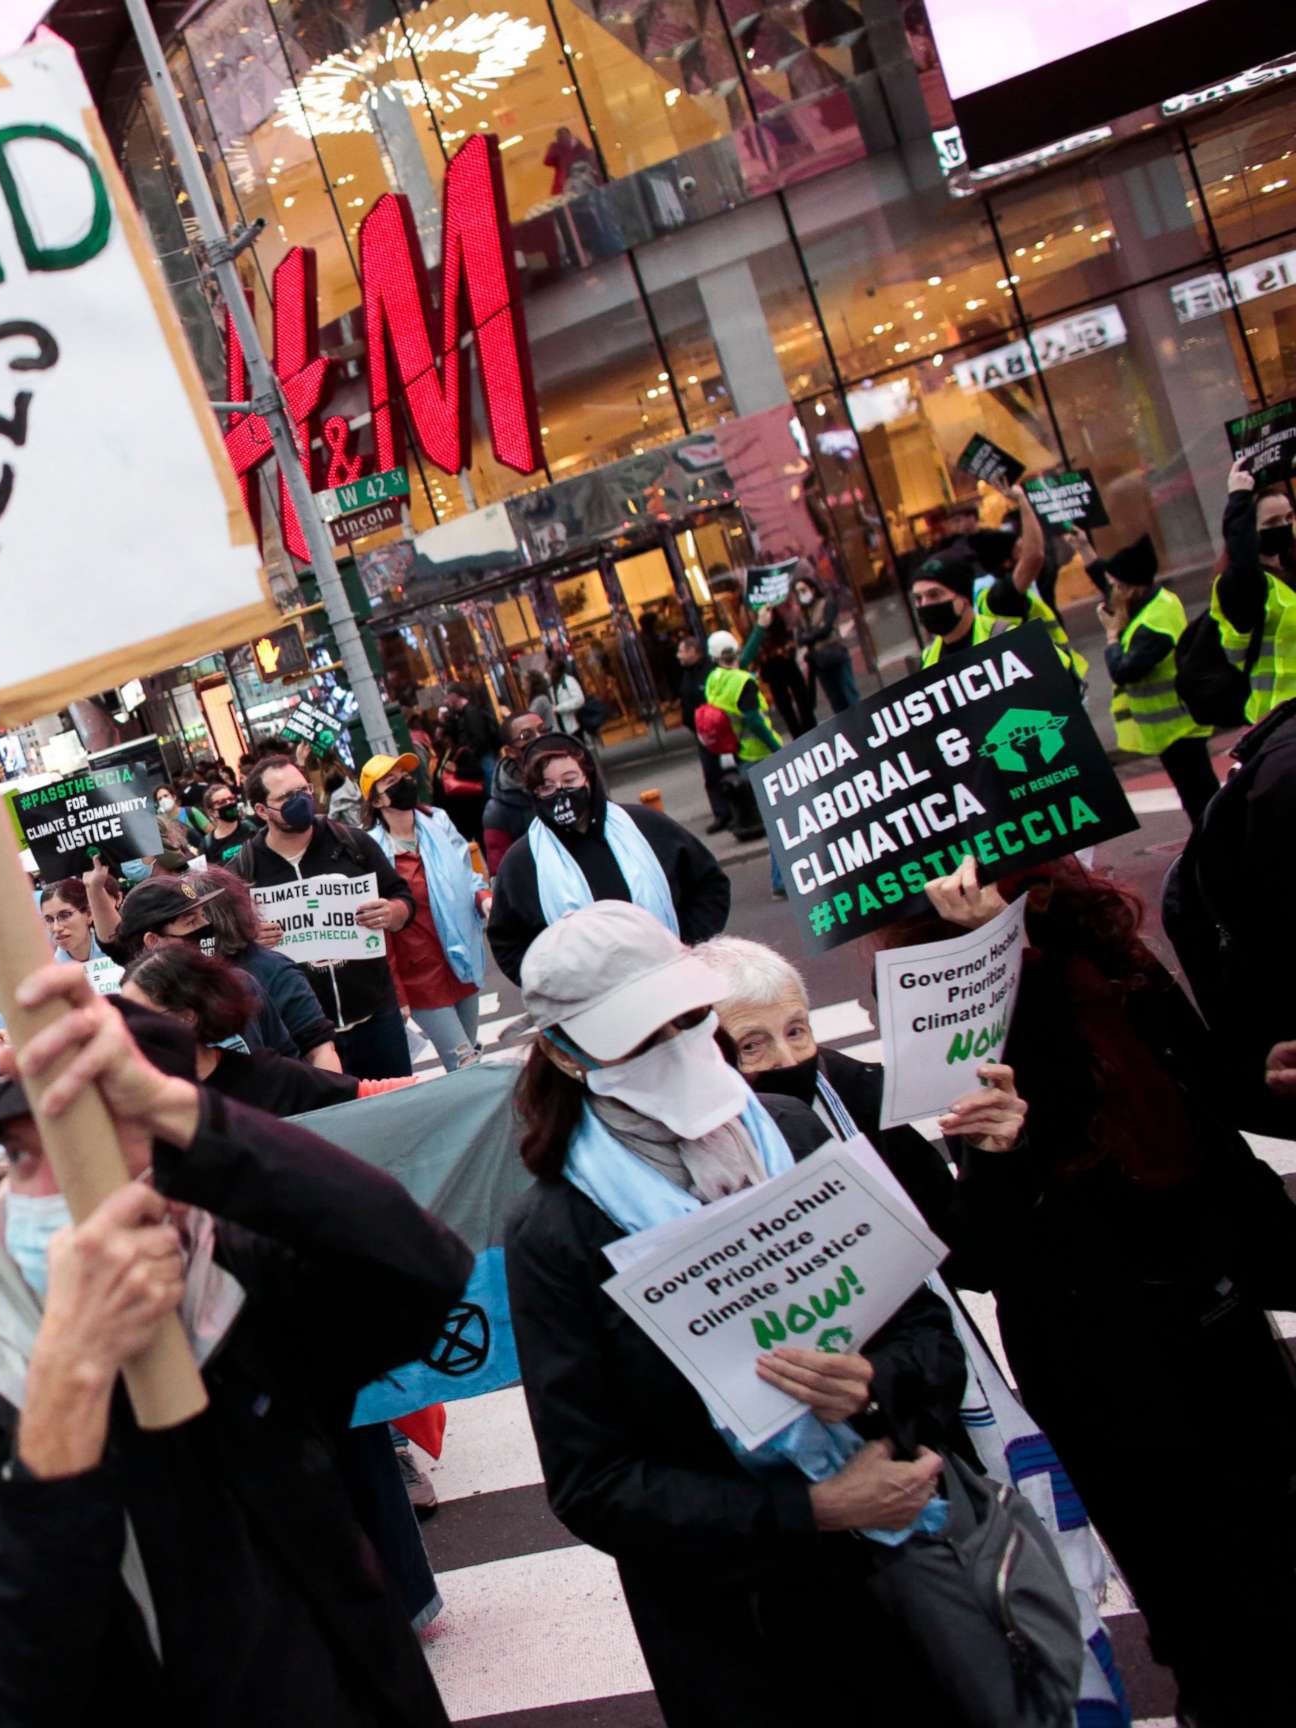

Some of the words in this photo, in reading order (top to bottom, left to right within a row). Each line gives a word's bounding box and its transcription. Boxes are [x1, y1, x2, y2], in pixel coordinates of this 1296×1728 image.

[223, 132, 550, 565] H&M
[340, 485, 359, 508] W
[366, 477, 388, 499] 42
[334, 506, 395, 538] Lincoln
[762, 732, 859, 807] FUNDA
[866, 650, 1035, 748] JUSTICIA
[21, 768, 134, 811] #PASSTHECCIA
[65, 795, 89, 812] FOR
[776, 750, 931, 851] LABORAL
[935, 728, 971, 768] &
[1009, 785, 1028, 801] NY
[1030, 765, 1080, 794] RENEWS
[26, 817, 66, 841] CLIMATE
[68, 815, 77, 827] &
[79, 796, 148, 824] COMMUNITY
[56, 817, 124, 853] JUSTICE
[790, 782, 986, 895] CLIMATICA
[807, 795, 1101, 937] #PASSTHECCIA
[254, 884, 309, 905] CLIMATE
[316, 880, 371, 897] JUSTICE
[271, 912, 315, 933] NION
[322, 911, 356, 928] JOB
[900, 954, 988, 990] Governor
[948, 962, 1007, 1003] Prioritize
[912, 1003, 986, 1033] Climate
[642, 1238, 748, 1306] Governor
[749, 1178, 846, 1243] Hochul:
[705, 1230, 815, 1296] Prioritize
[687, 1279, 780, 1337] Climate
[786, 1221, 872, 1286] Justice
[751, 1265, 866, 1350] NOW!
